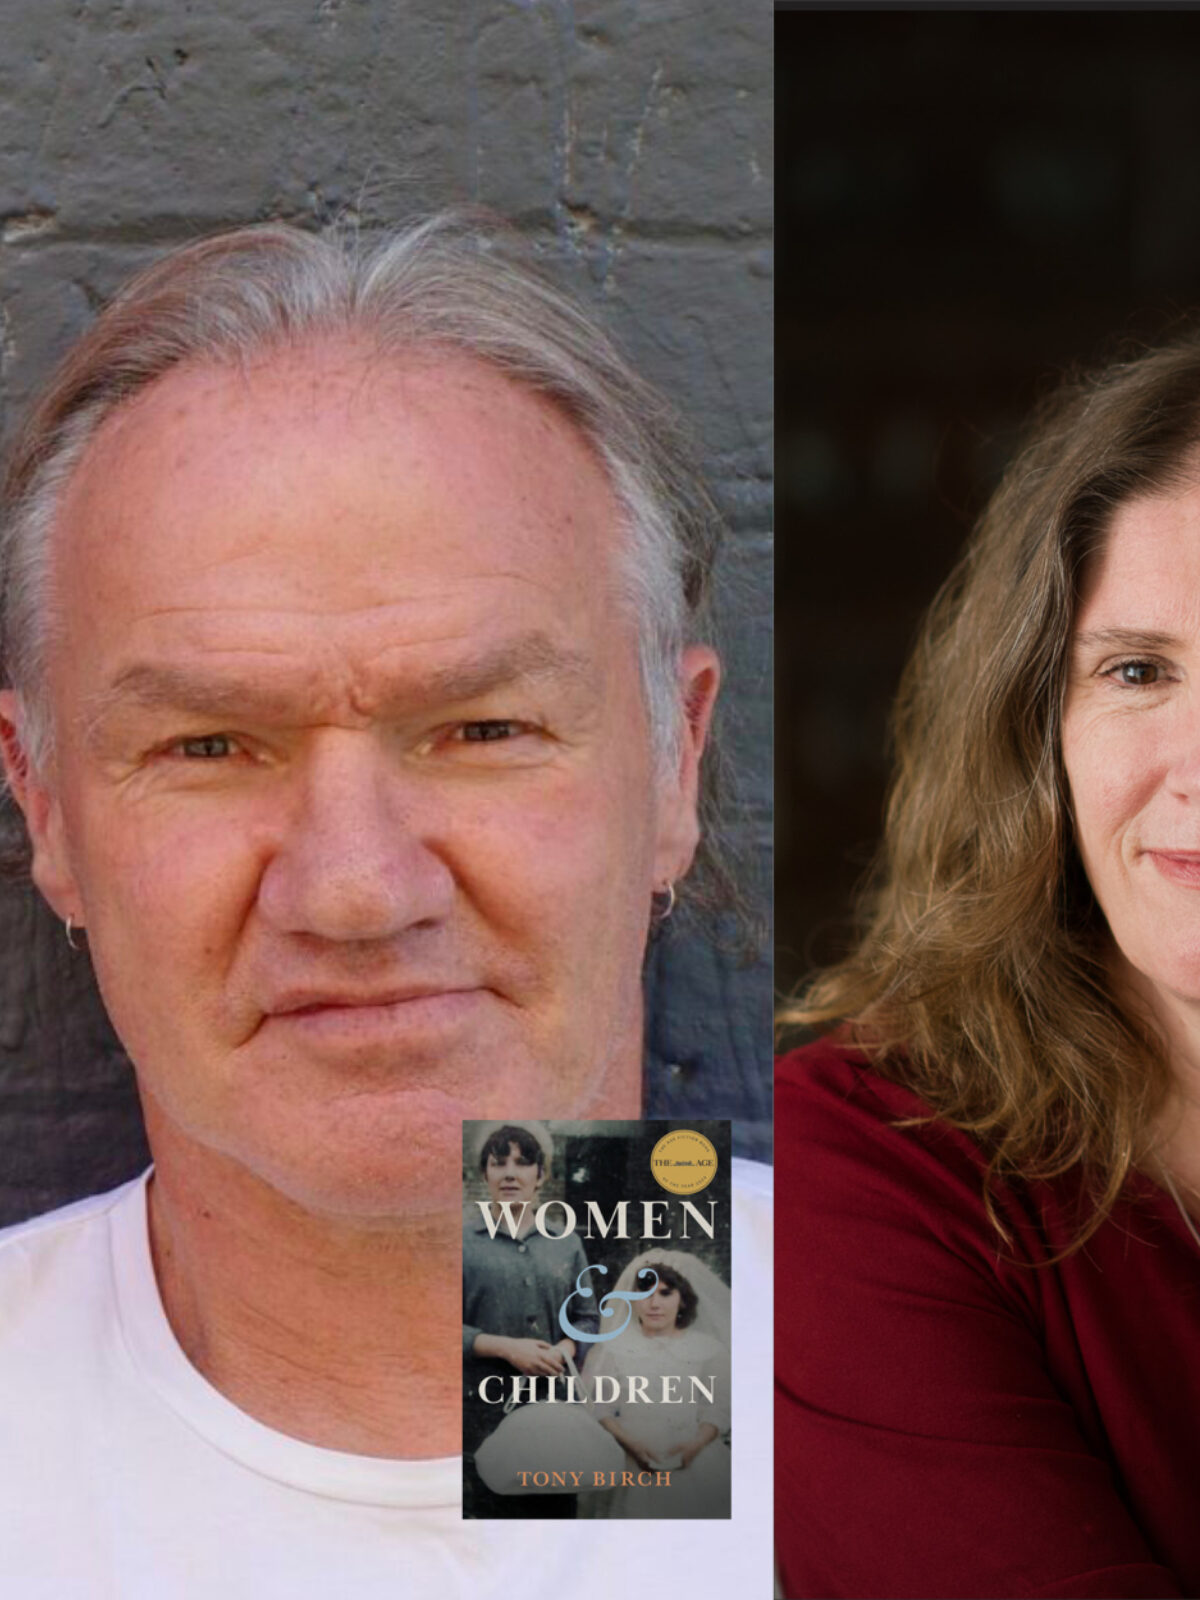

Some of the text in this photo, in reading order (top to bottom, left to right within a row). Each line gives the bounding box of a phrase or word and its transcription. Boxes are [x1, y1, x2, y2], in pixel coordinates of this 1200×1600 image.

[475, 1200, 719, 1240] WOMEN
[558, 1264, 659, 1343] &
[478, 1375, 716, 1405] CHILDREN
[517, 1471, 672, 1487] TONY BIRCH
